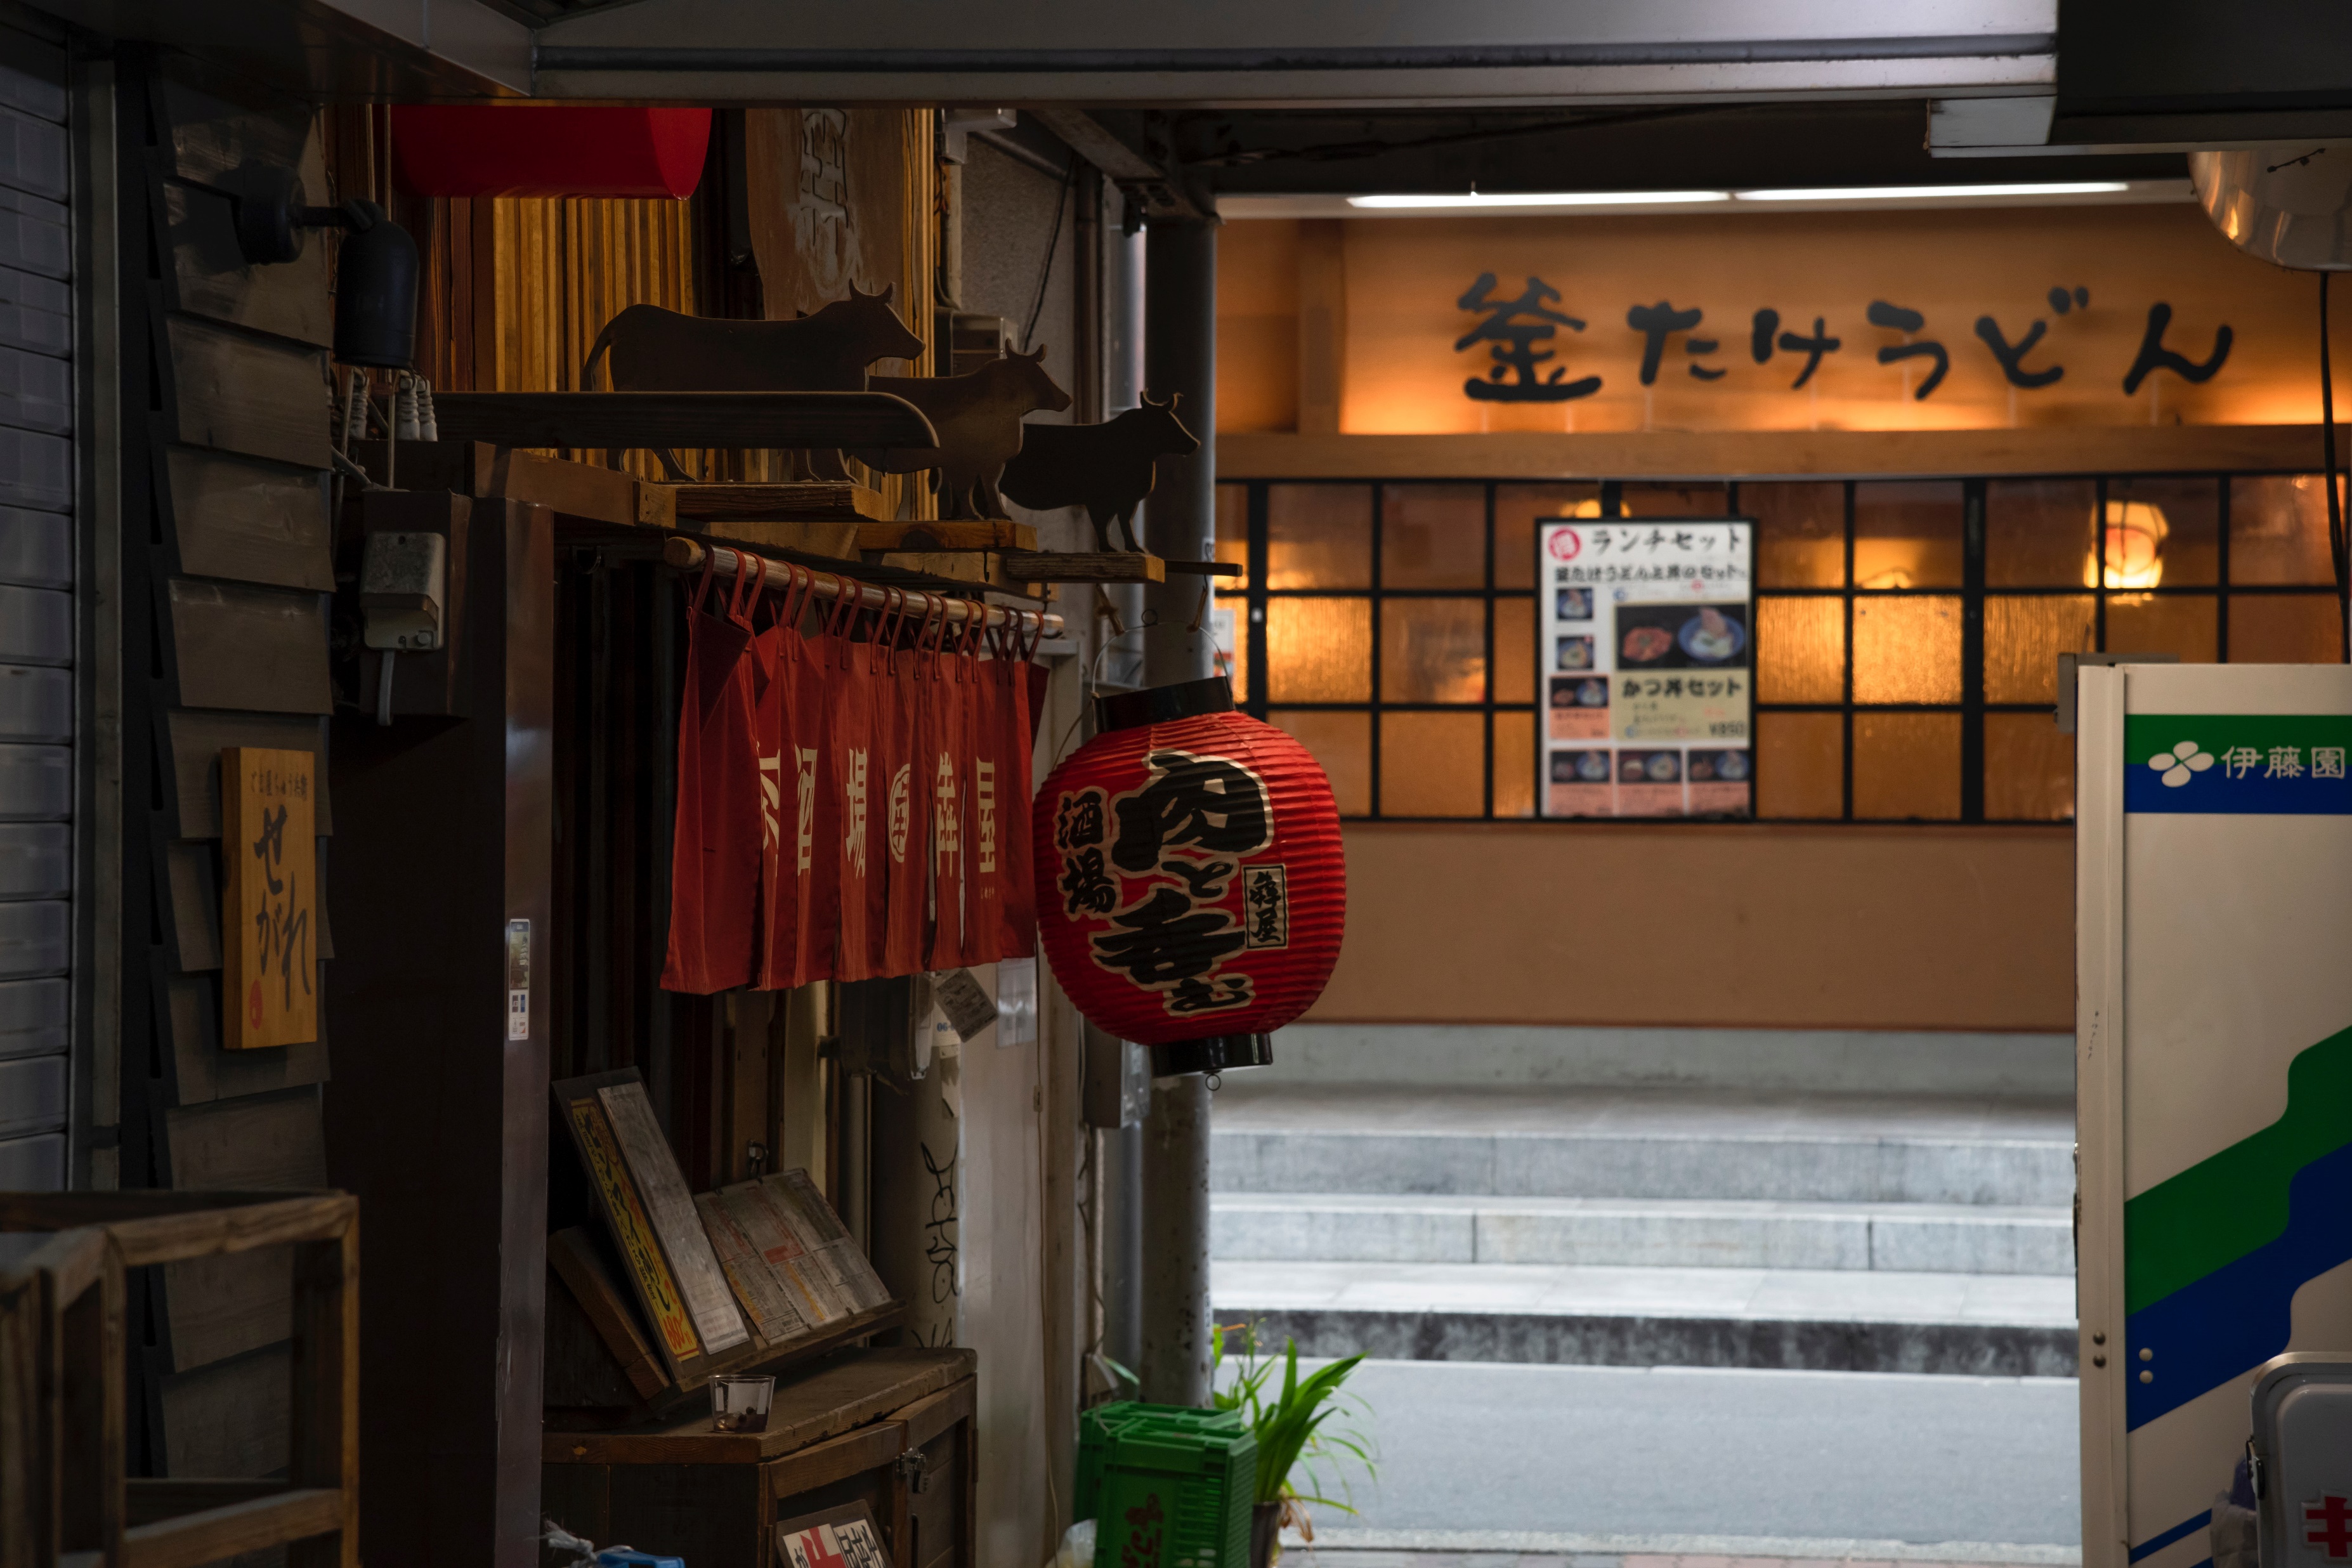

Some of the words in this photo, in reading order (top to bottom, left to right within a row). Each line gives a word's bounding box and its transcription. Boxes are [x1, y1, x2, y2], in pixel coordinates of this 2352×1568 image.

[1454, 271, 2234, 403] 釜たけうどん
[1590, 524, 1743, 556] ランチセット
[1621, 676, 1742, 698] かつ丼セット
[2220, 745, 2346, 780] 伊藤園
[1057, 791, 1118, 915] 酒場
[253, 804, 311, 1012] せがれ
